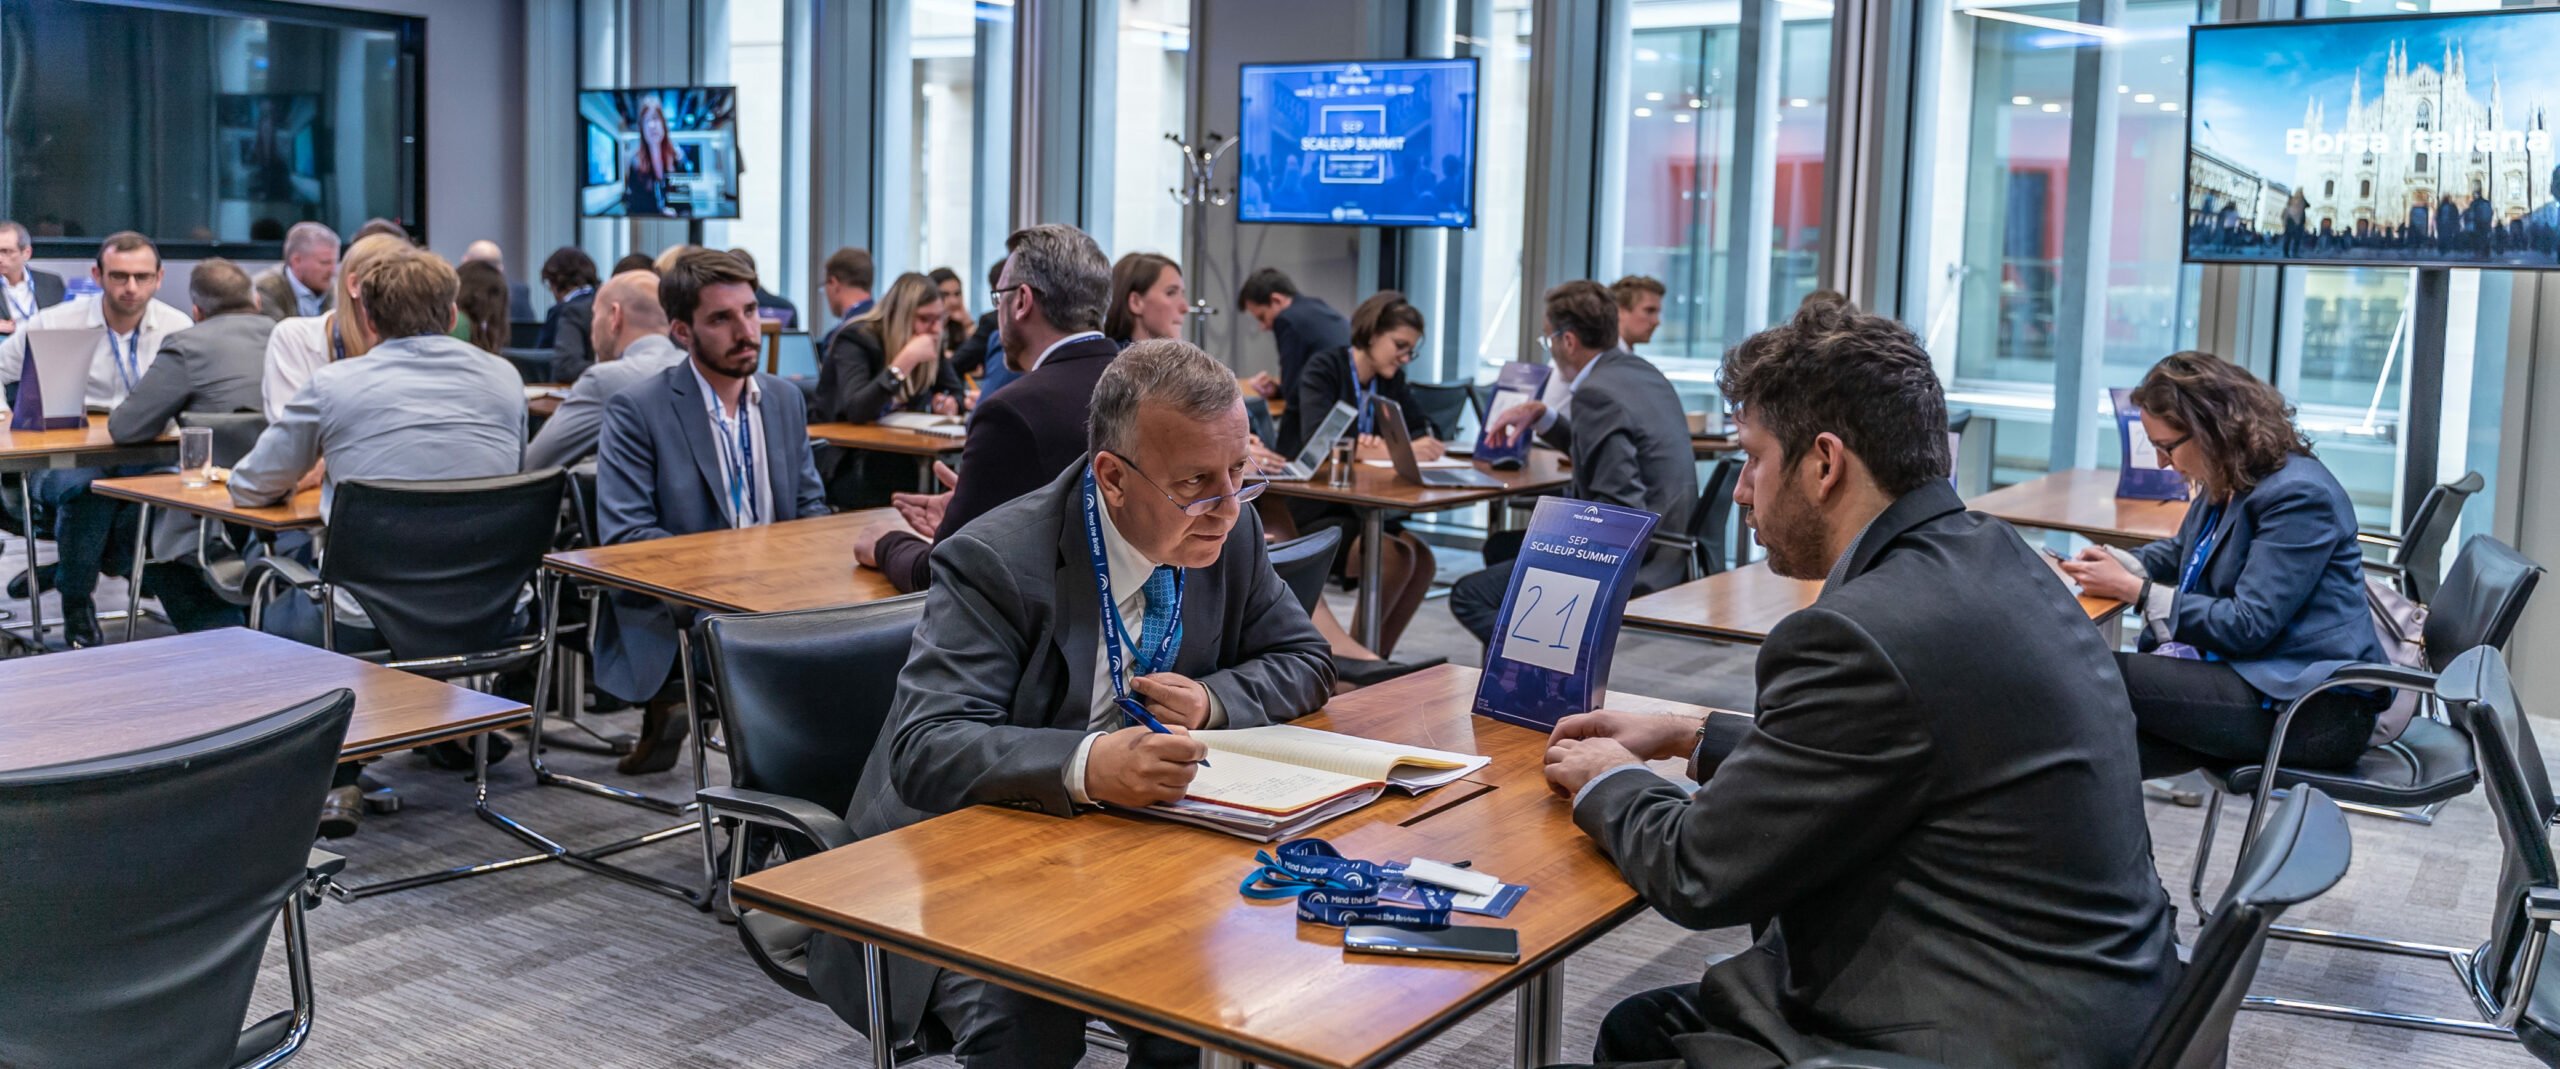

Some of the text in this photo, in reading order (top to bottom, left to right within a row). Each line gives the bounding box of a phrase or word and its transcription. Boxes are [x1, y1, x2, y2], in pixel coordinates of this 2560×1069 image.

[1341, 120, 1364, 134] SEP
[1301, 136, 1406, 152] SCALEUP SUMMIT
[2286, 125, 2549, 155] Borsa Italiana
[1568, 535, 1589, 545] SEP
[1530, 541, 1619, 565] SCALEUP SUMMIT
[1511, 585, 1579, 650] 21
[1284, 861, 1329, 876] Mind the Bridge
[1331, 895, 1349, 905] Mind
[1351, 895, 1364, 905] the
